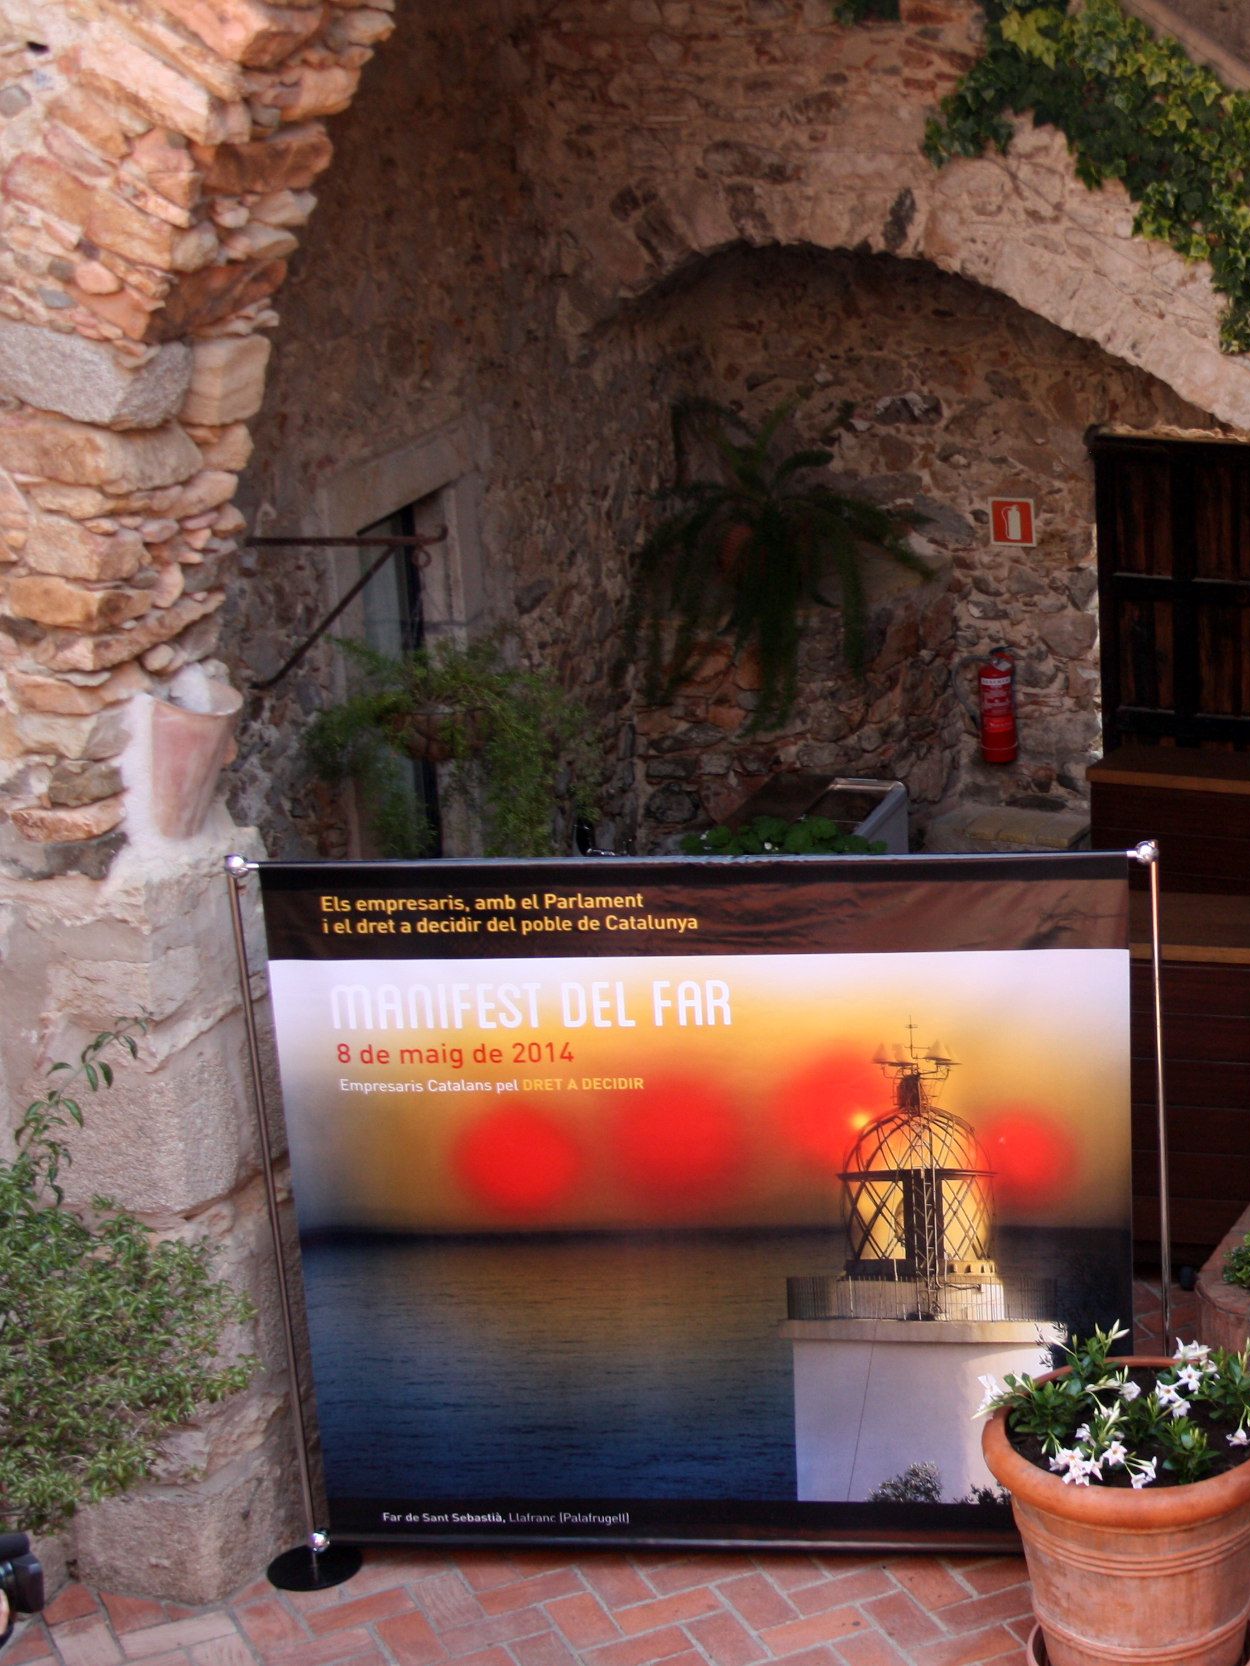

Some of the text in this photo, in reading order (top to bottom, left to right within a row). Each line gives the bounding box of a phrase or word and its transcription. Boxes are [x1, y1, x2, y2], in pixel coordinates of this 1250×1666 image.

[320, 893, 644, 915] Els empresaris, amb el Parlament
[322, 914, 699, 935] i el dret a decidir del poble de Catalunya
[330, 979, 733, 1030] MANIFEST DEL FAR
[337, 1042, 574, 1069] 8 de maig de 2014
[339, 1077, 644, 1094] Empresaris Catalans pel DRET A DECIDIR
[383, 1512, 402, 1522] Far
[405, 1512, 420, 1522] de
[422, 1513, 449, 1522] Sant
[508, 1512, 556, 1523] Llafranc
